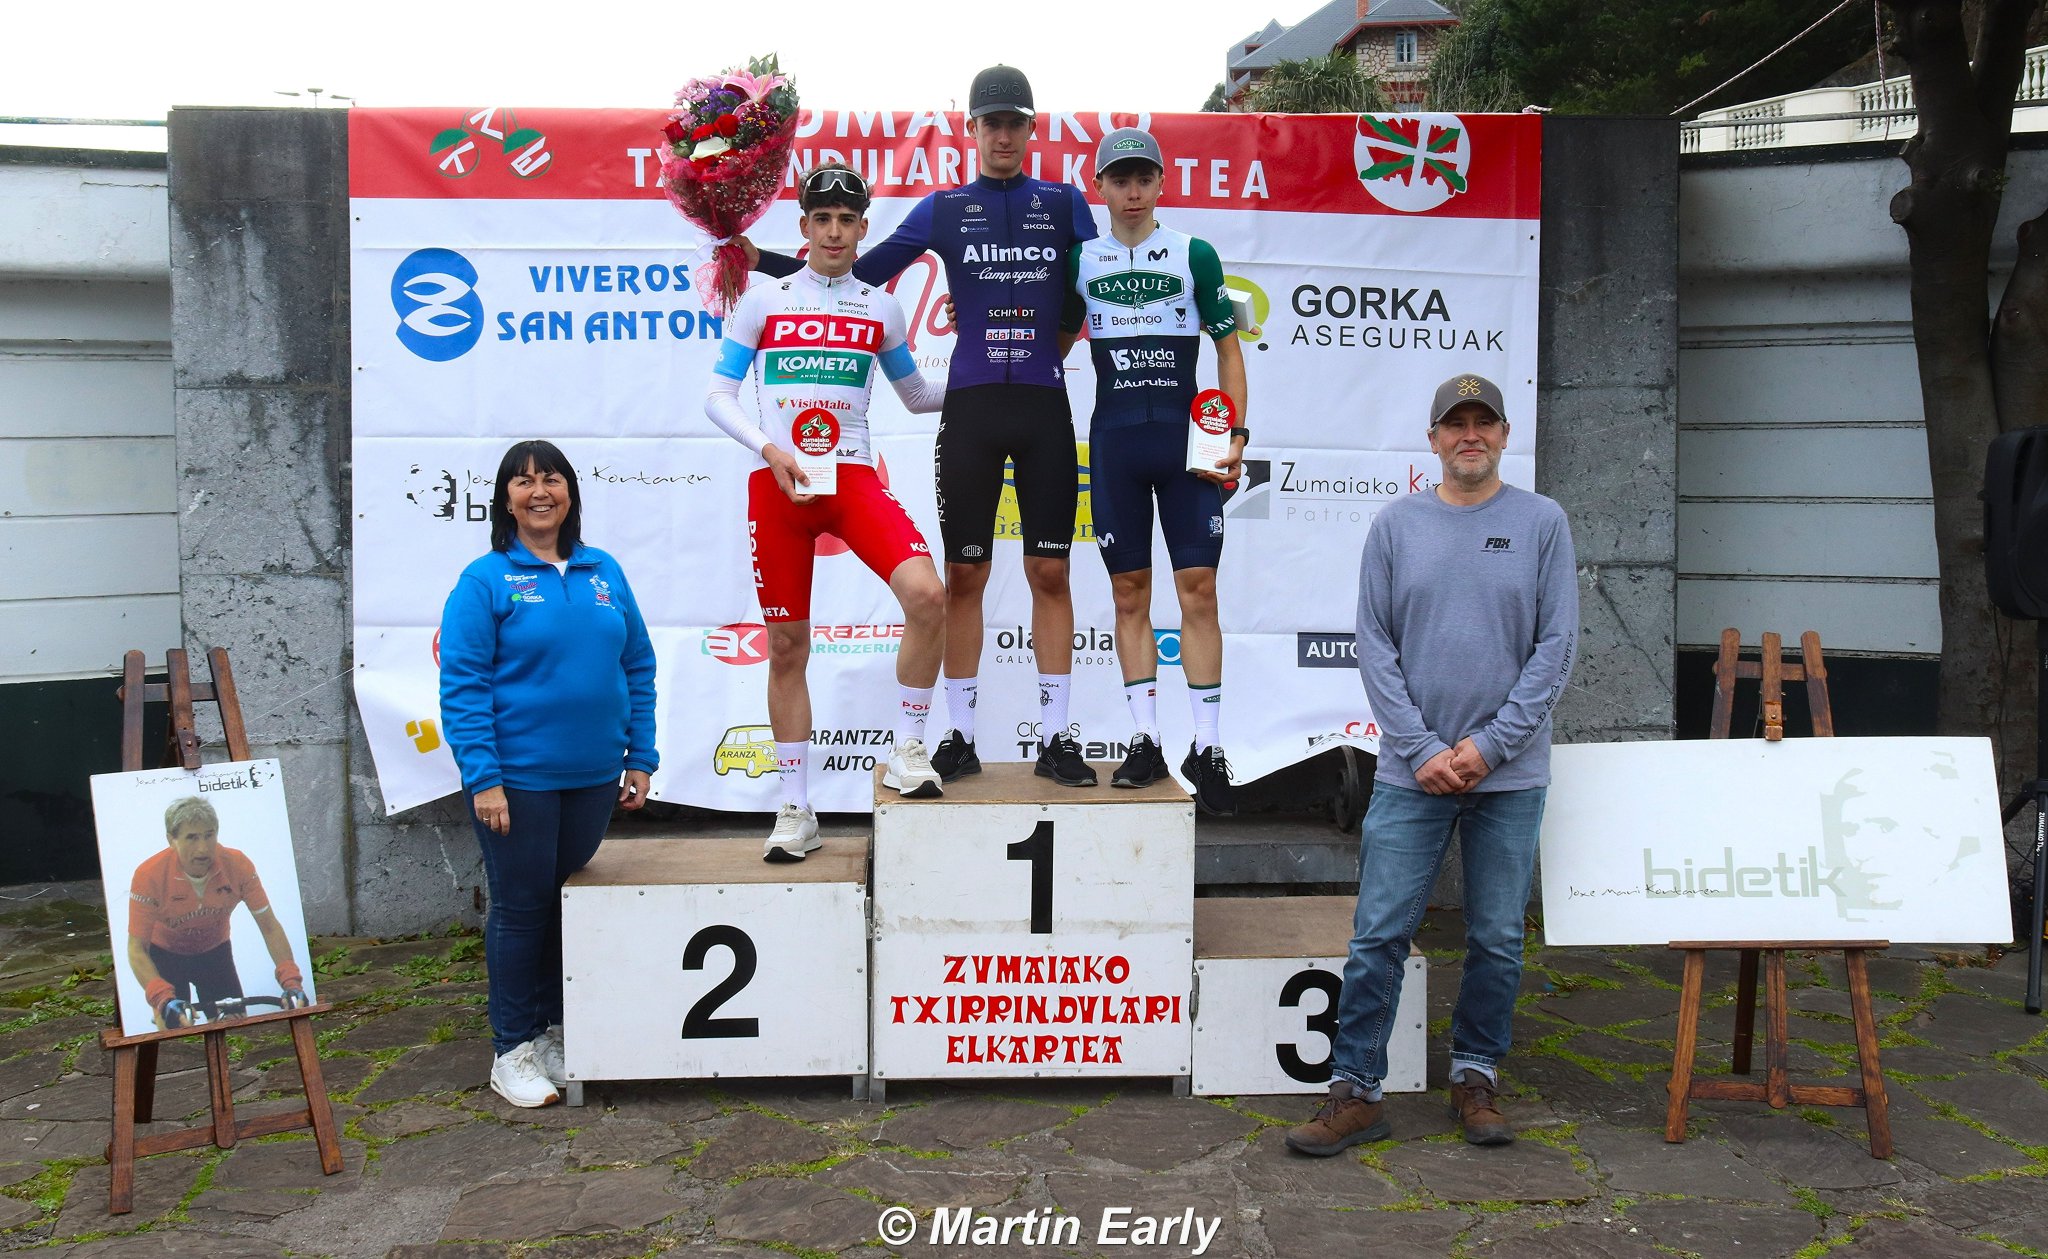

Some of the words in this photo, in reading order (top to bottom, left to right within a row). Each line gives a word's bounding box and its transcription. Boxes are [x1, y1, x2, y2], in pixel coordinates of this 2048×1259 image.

[963, 244, 1057, 264] Alimco
[529, 263, 692, 296] VIVEROS
[1097, 277, 1170, 295] BAQUÉ
[837, 301, 869, 309] GSPORT
[988, 306, 1035, 318] SCHMIDT
[1291, 284, 1451, 322] GORKA
[496, 311, 574, 344] SAN
[1111, 315, 1162, 326] Berango
[773, 320, 875, 345] POLTI
[1291, 324, 1504, 352] ASEGURUAK
[777, 356, 859, 373] KOMETA
[1130, 348, 1175, 362] Viuda
[1124, 378, 1179, 390] Aurubis
[1280, 461, 1398, 495] Zumaiako
[1485, 537, 1511, 549] FOX
[720, 750, 757, 759] ARANZA
[198, 776, 248, 792] bidetik
[1006, 821, 1054, 934] 1
[1643, 846, 1848, 899] bidetik
[682, 925, 759, 1039] 2
[1276, 969, 1345, 1083] 3
[946, 1034, 1123, 1064] ELKARTEA
